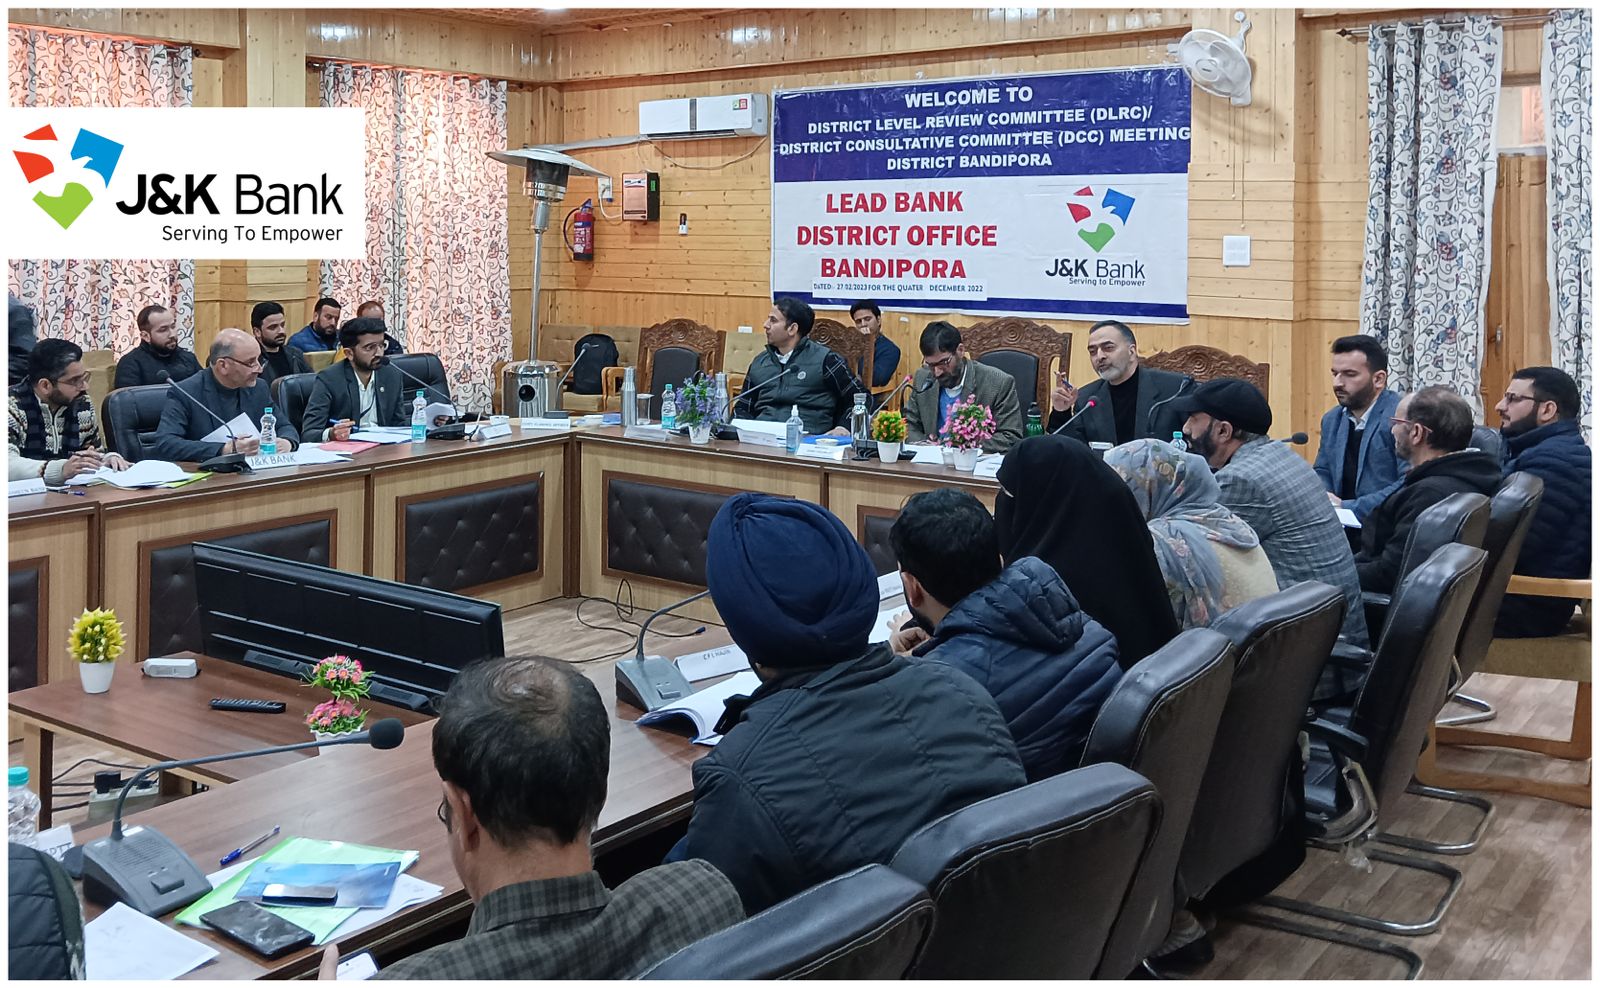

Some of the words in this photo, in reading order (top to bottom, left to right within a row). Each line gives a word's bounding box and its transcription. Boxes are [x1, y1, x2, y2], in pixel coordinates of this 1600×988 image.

[905, 89, 1000, 108] WELCOME
[1006, 86, 1033, 103] TO
[808, 120, 871, 134] DISTRICT
[876, 117, 921, 131] LEVEL
[926, 113, 983, 128] REVIEW
[988, 109, 1085, 126] COMMITTEE
[1090, 105, 1152, 124] (DLRC)/
[780, 141, 842, 155] DISTRICT
[845, 136, 954, 151] CONSULTATIVE
[959, 131, 1053, 147] COMMITTEE
[1058, 129, 1104, 147] (DCC)
[1110, 127, 1191, 142] MEETING
[887, 156, 955, 170] DISTRICT
[960, 153, 1052, 167] BANDIPORA
[826, 193, 887, 214] LEAD
[894, 191, 964, 213] BANK
[797, 225, 900, 246] DISTRICT
[907, 225, 997, 247] OFFICE
[821, 258, 966, 279] BANDIPORA
[1045, 258, 1089, 278] J&K
[1096, 259, 1146, 279] Bank
[883, 284, 896, 292] THE
[929, 285, 966, 293] DECEMBER
[967, 285, 984, 293] 2022
[1069, 277, 1097, 286] Serving
[1099, 278, 1107, 286] to
[1109, 278, 1146, 287] Empower
[250, 457, 269, 467] J&K
[270, 454, 296, 466] BANK
